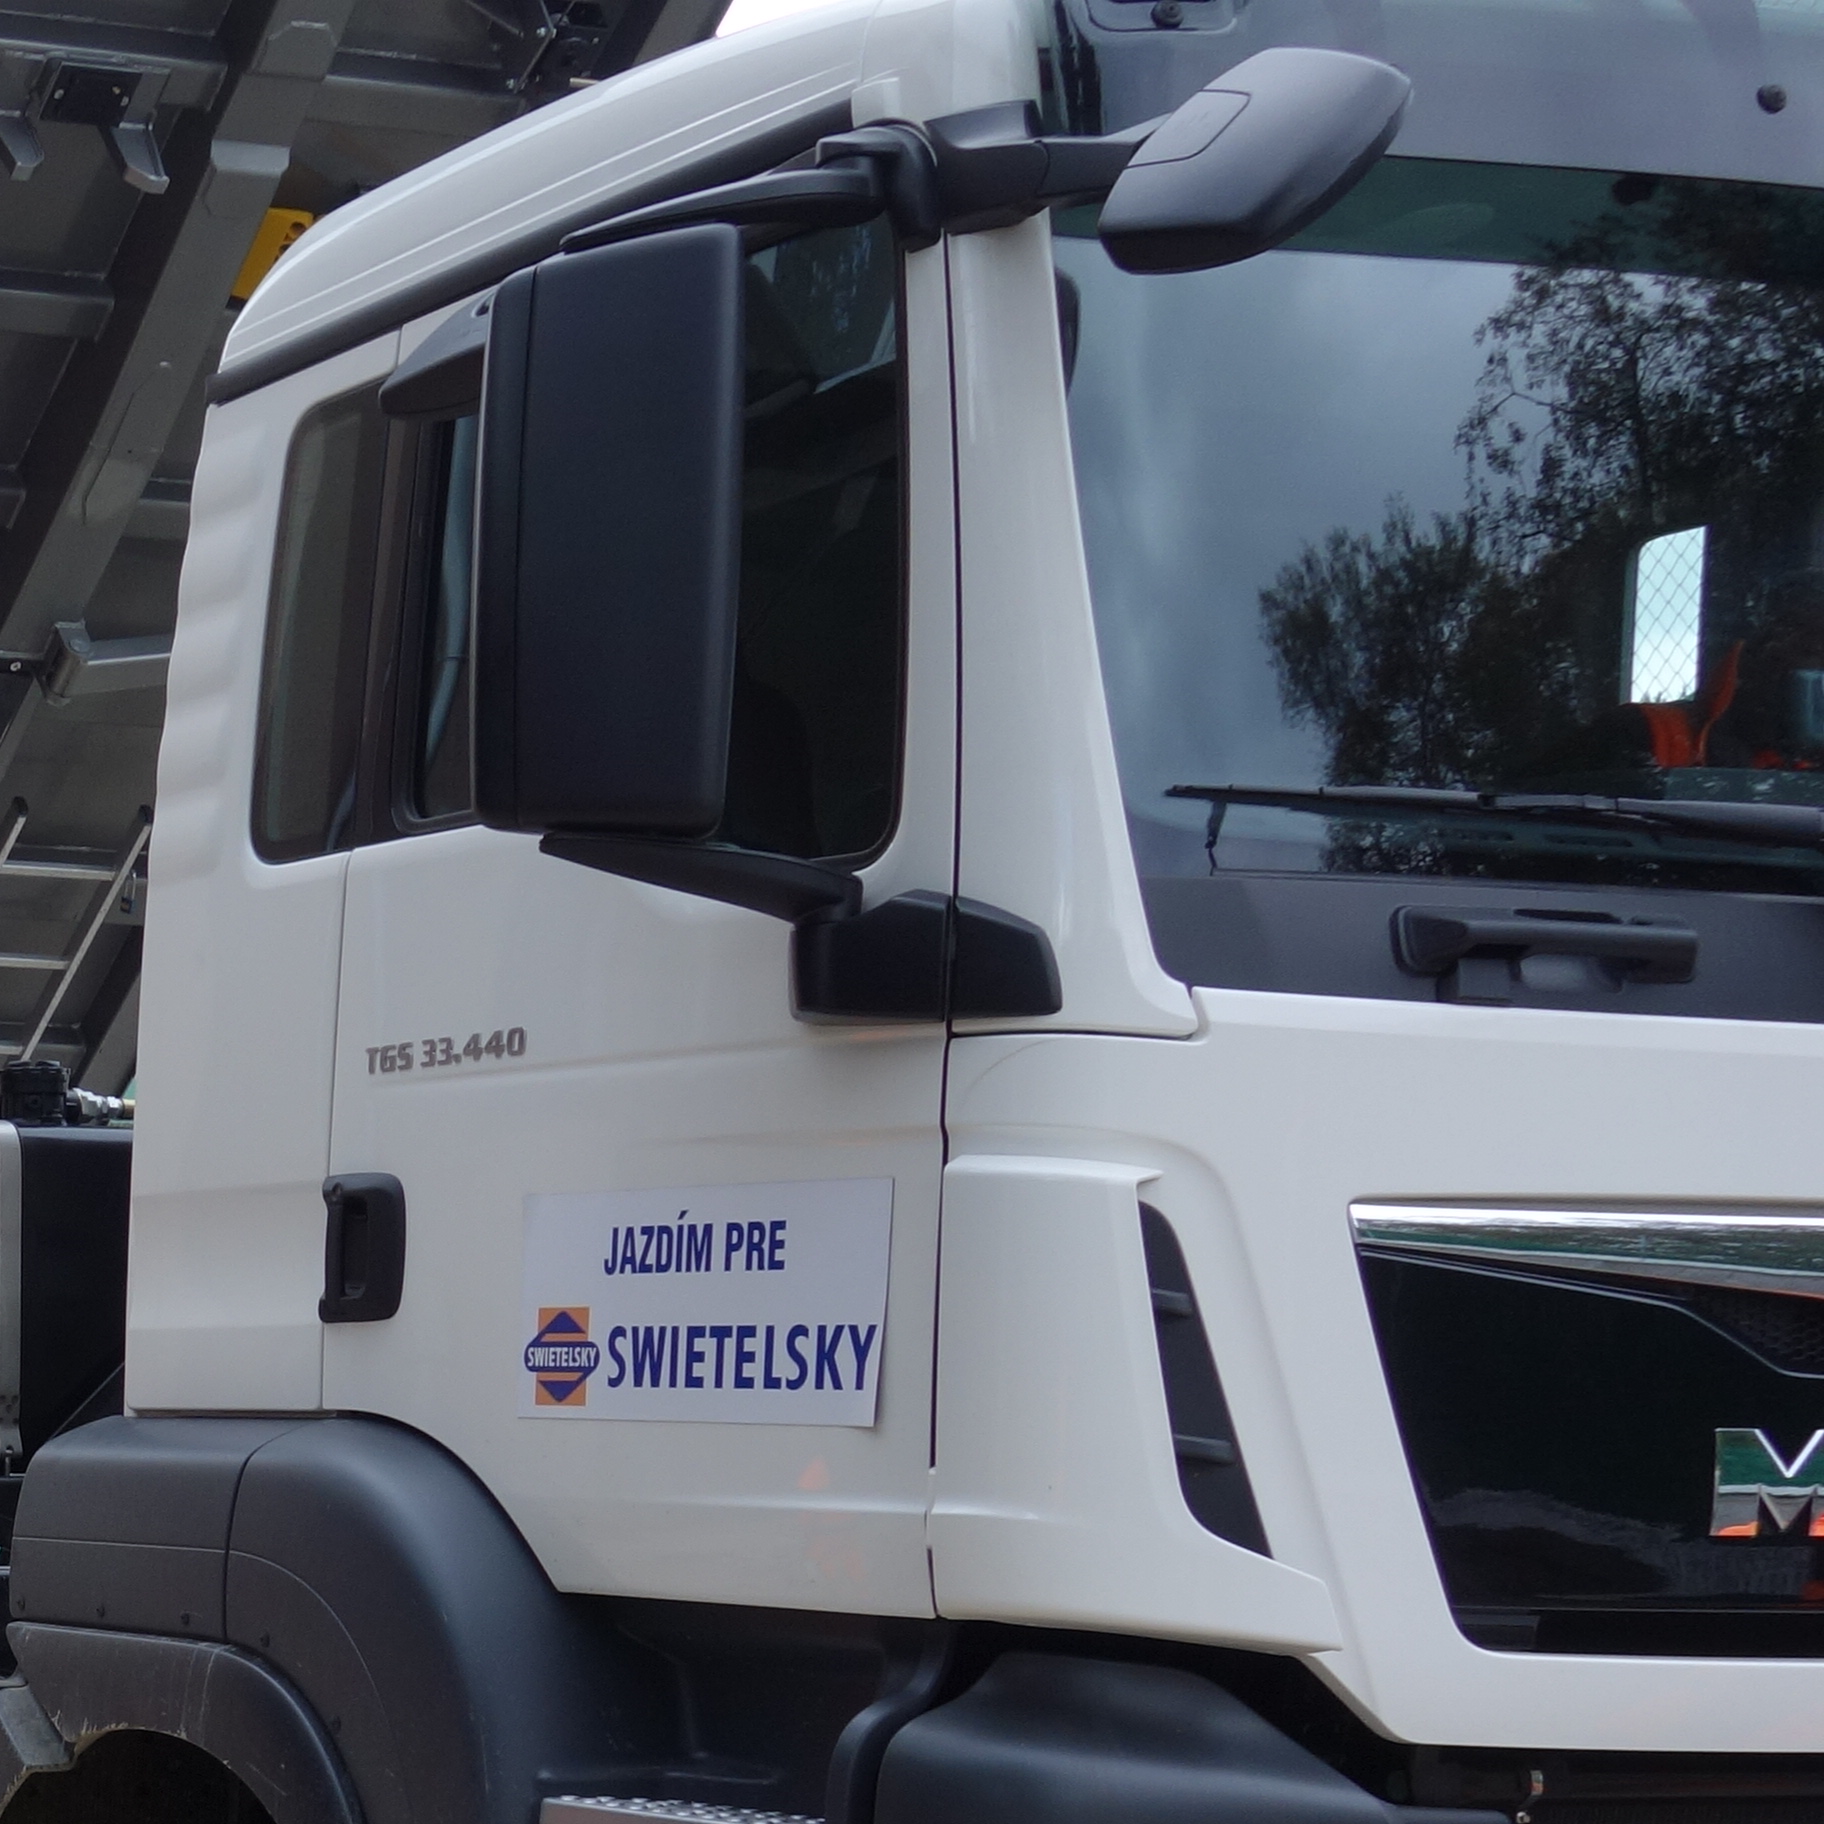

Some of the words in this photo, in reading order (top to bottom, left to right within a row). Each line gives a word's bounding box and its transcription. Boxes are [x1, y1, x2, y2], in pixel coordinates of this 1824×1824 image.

[365, 1041, 414, 1075] TGS
[420, 1026, 528, 1067] 33.440
[603, 1209, 714, 1276] JAZDÍM
[723, 1219, 788, 1273] PRE
[527, 1346, 597, 1368] SWIETELSKY
[606, 1323, 879, 1392] SWIETELSKY
